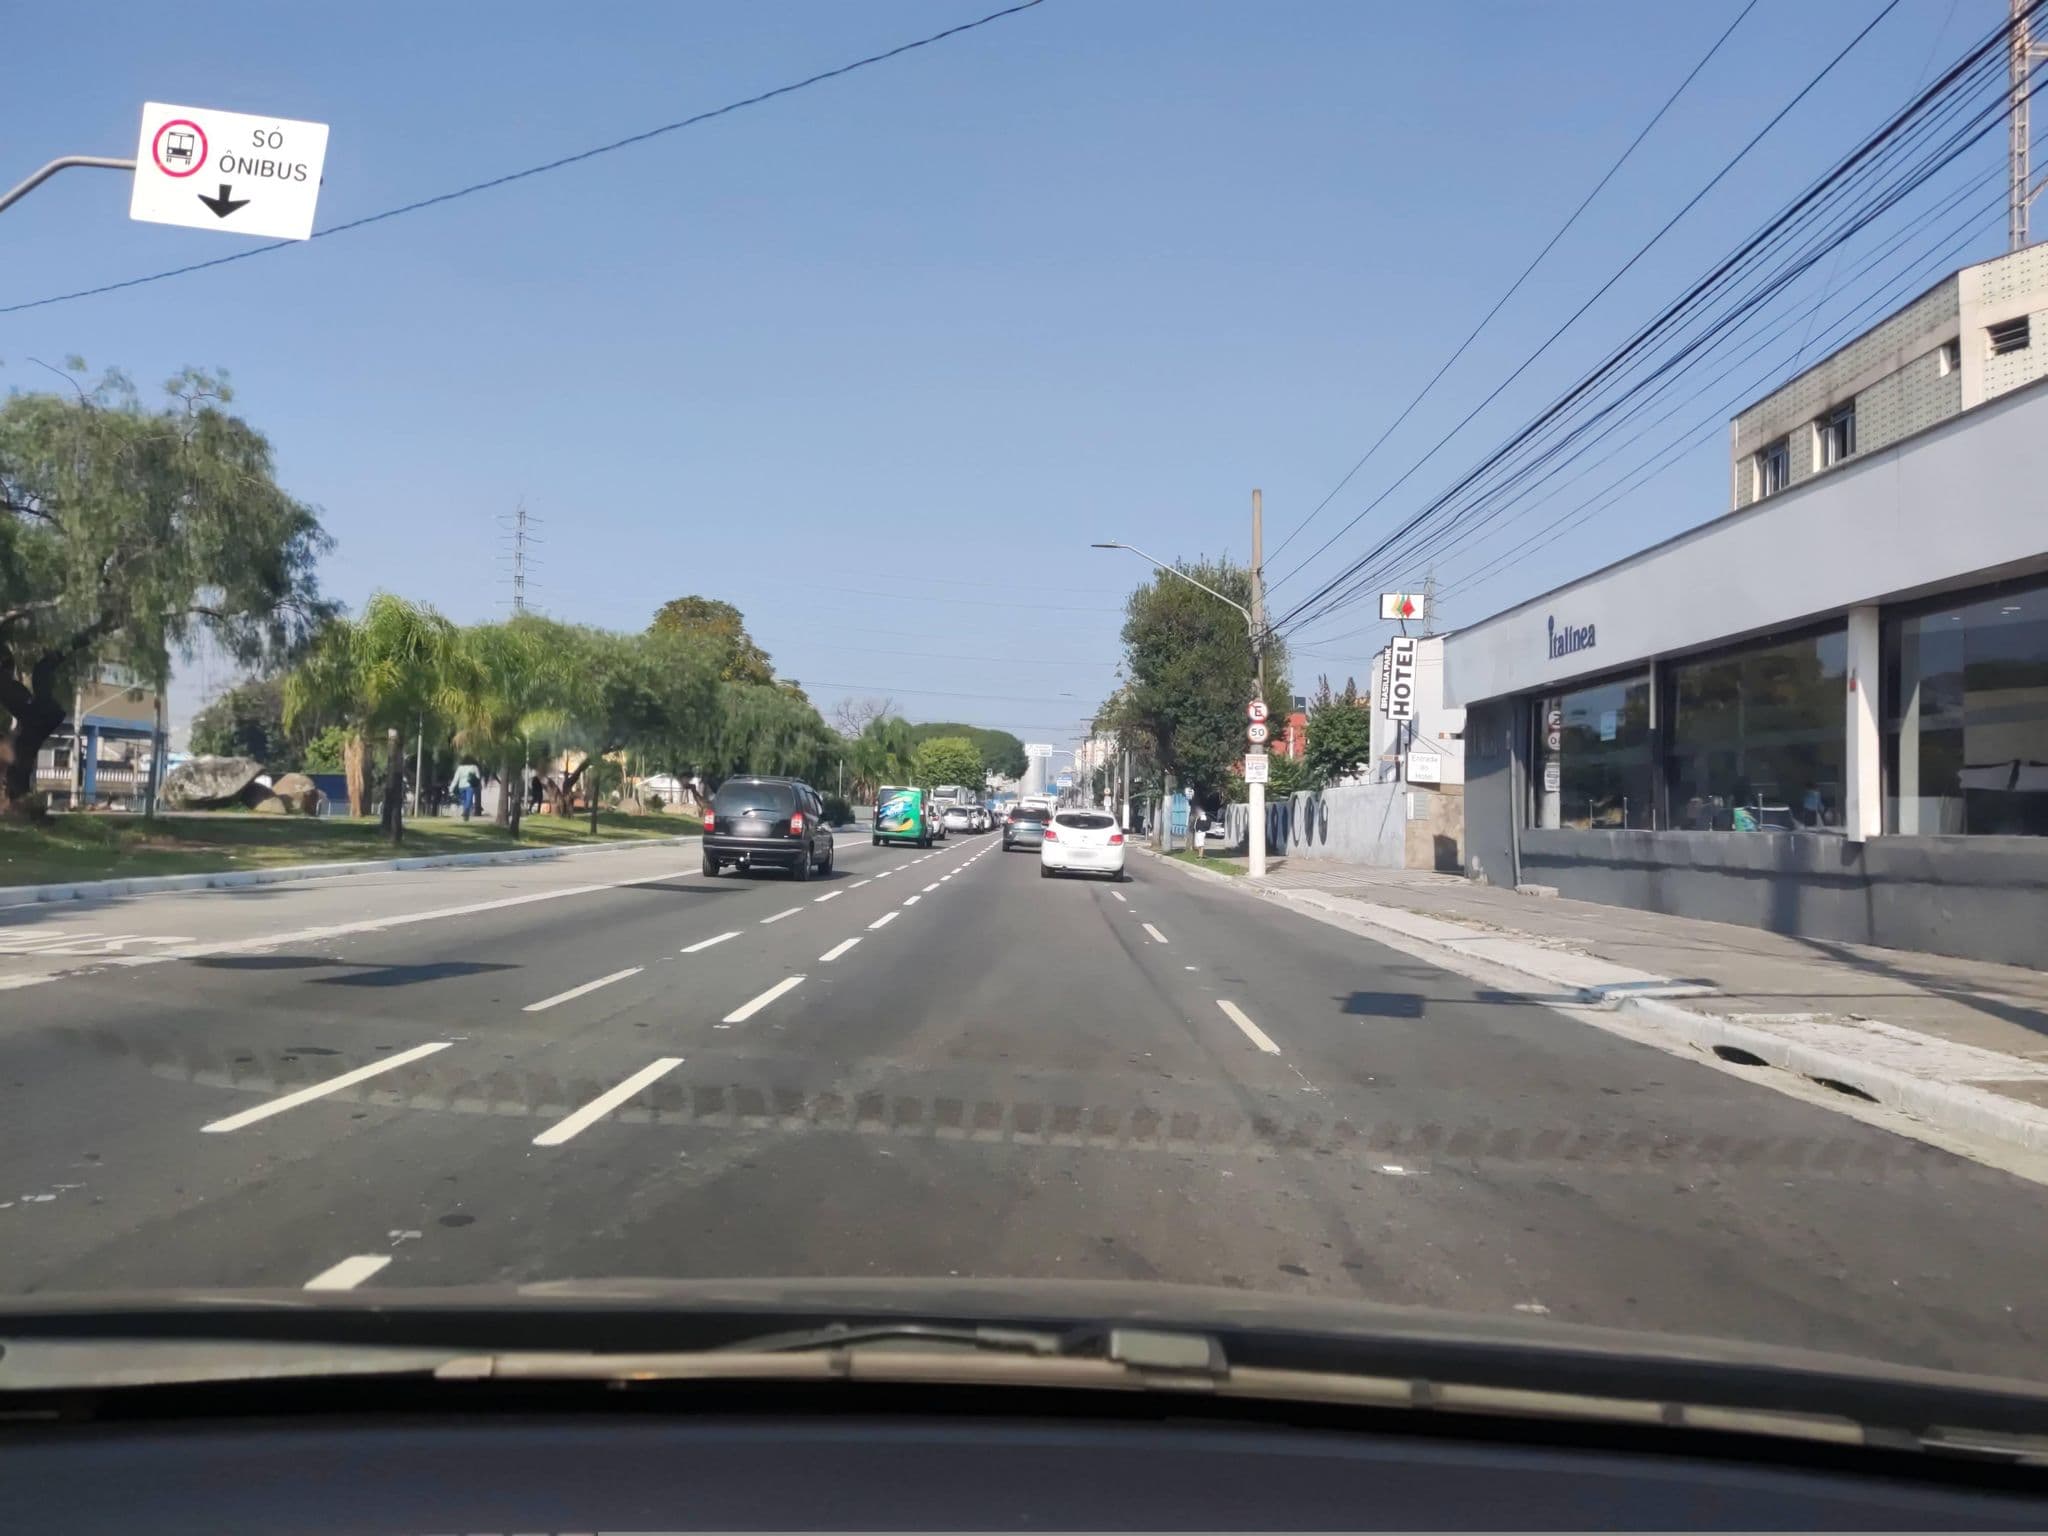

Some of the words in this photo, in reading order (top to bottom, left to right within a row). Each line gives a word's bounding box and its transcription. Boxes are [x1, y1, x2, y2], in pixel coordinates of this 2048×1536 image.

[252, 126, 284, 150] SÓ
[219, 149, 308, 182] ÔNIBUS
[1383, 647, 1392, 671] PARK
[1393, 640, 1413, 715] HOTEL
[1254, 705, 1264, 717] E
[1251, 728, 1265, 737] 50
